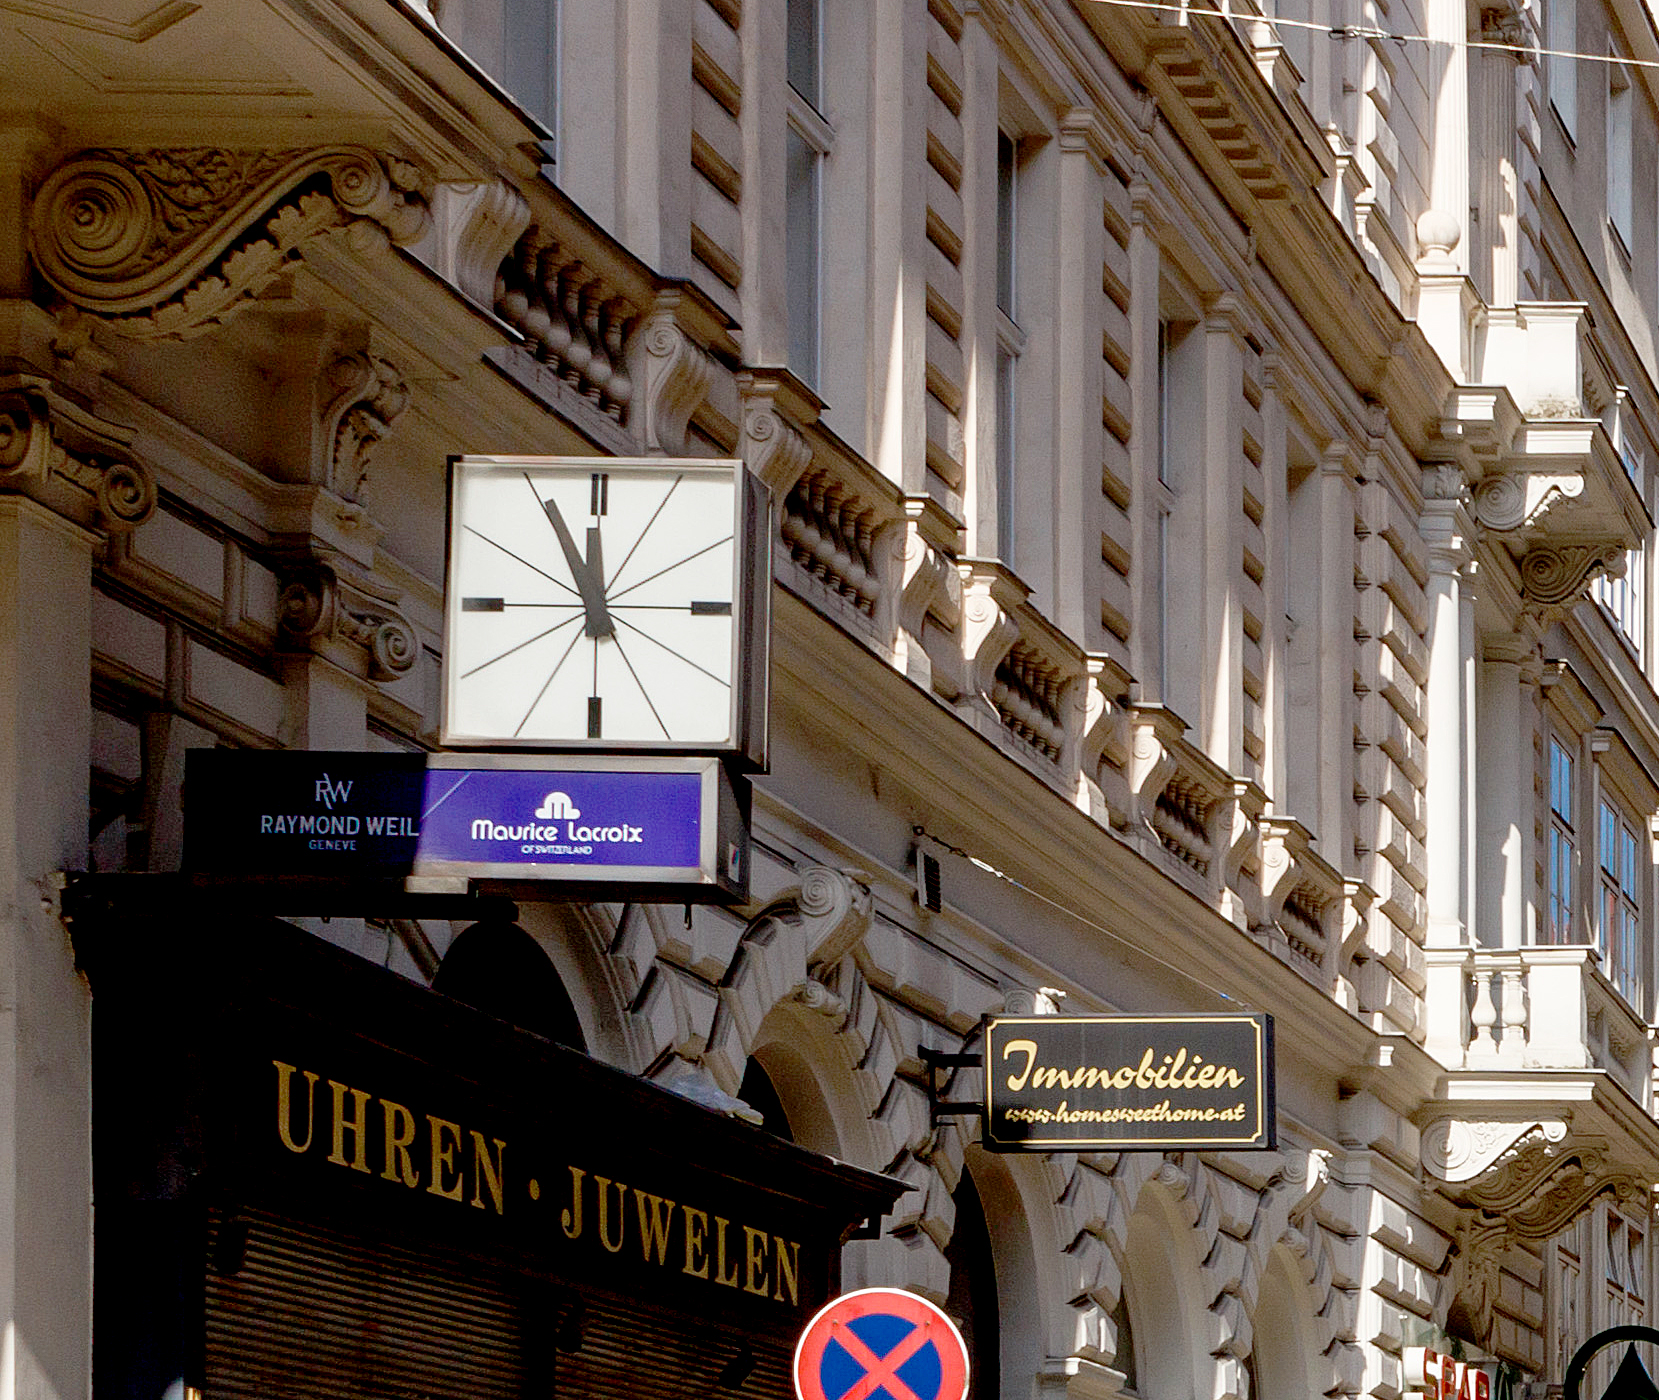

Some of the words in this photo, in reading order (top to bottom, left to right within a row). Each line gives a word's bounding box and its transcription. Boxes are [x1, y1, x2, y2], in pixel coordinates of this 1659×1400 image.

[261, 815, 360, 835] RAYMOND
[366, 817, 420, 837] WEIL
[471, 819, 559, 841] Maurice
[568, 821, 643, 843] Lacroix
[308, 839, 357, 850] GENEVE
[535, 845, 593, 855] SWITZERLAND
[1003, 1039, 1245, 1092] Immobilien
[1005, 1100, 1246, 1124] www.homesweethome.at
[272, 1060, 506, 1216] UHREN
[562, 1165, 801, 1306] JUWELEN
